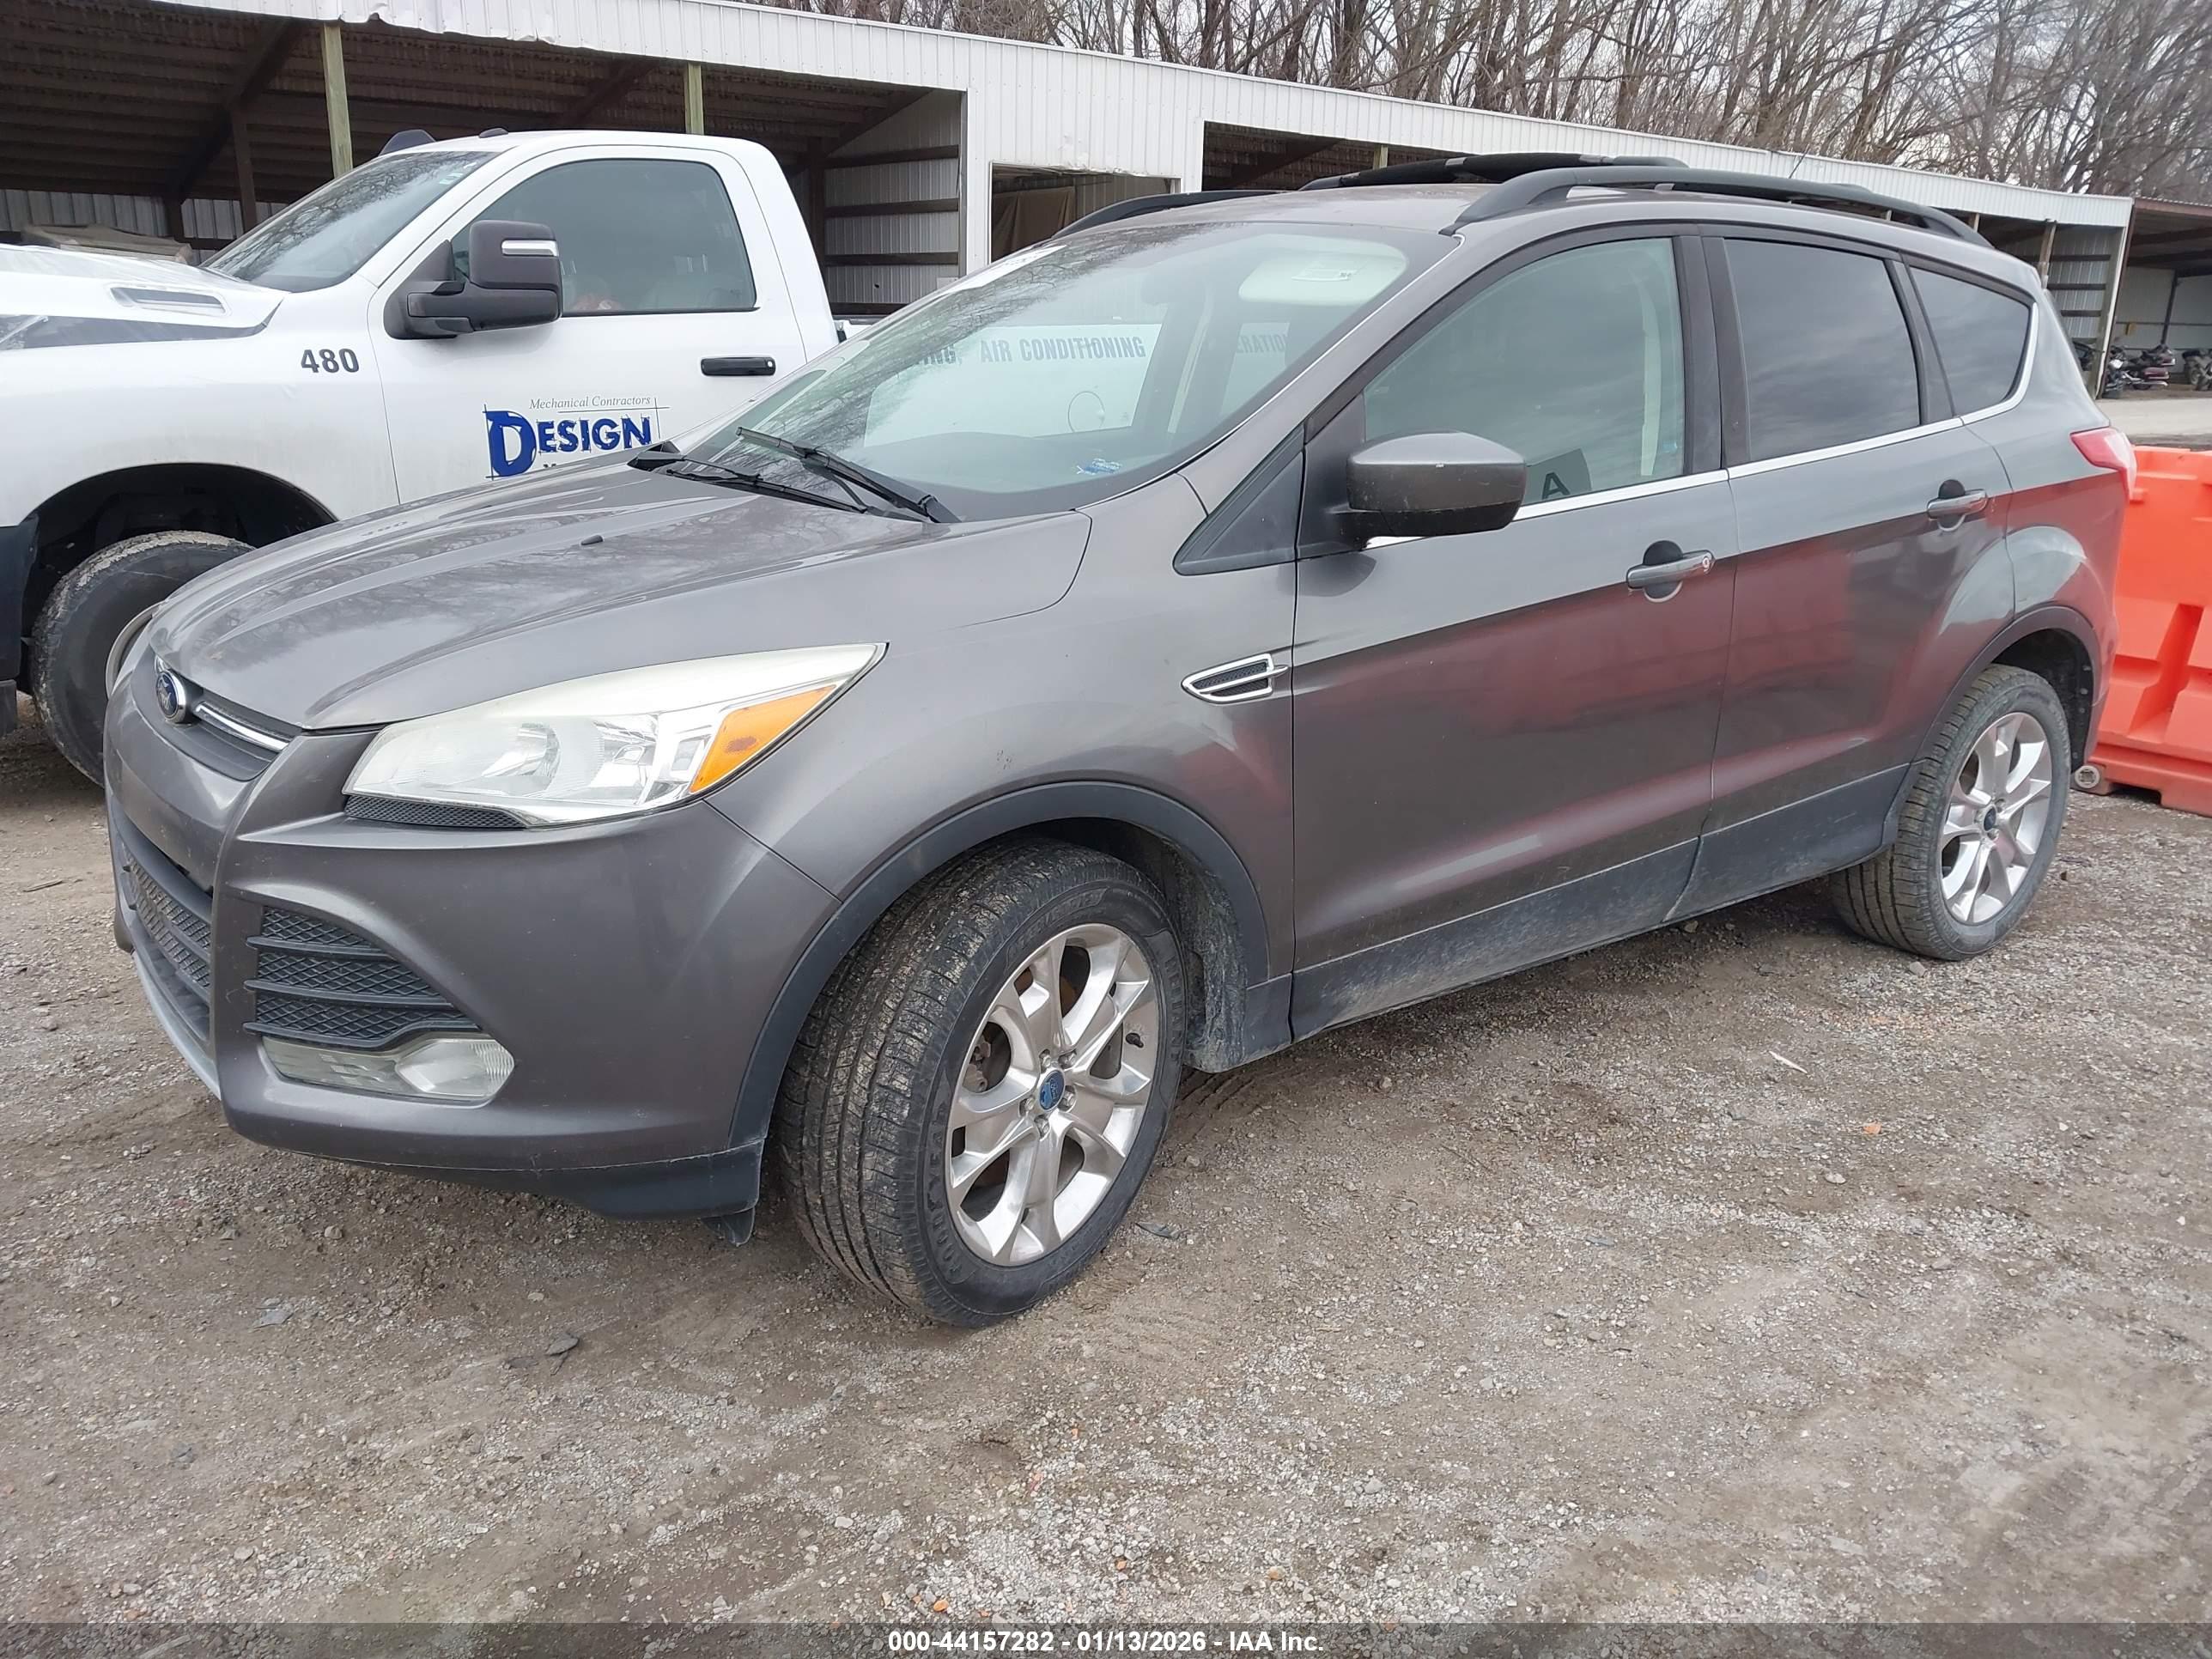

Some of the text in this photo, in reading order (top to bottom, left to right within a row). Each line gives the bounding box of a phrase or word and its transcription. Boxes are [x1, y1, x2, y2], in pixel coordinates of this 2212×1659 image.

[301, 348, 360, 374] 480
[981, 339, 1013, 363] AIR
[1018, 336, 1146, 362] CONDITIONING
[529, 395, 651, 410] Mechanical Contractors
[483, 410, 653, 477] DESIGN
[1541, 471, 1571, 501] A
